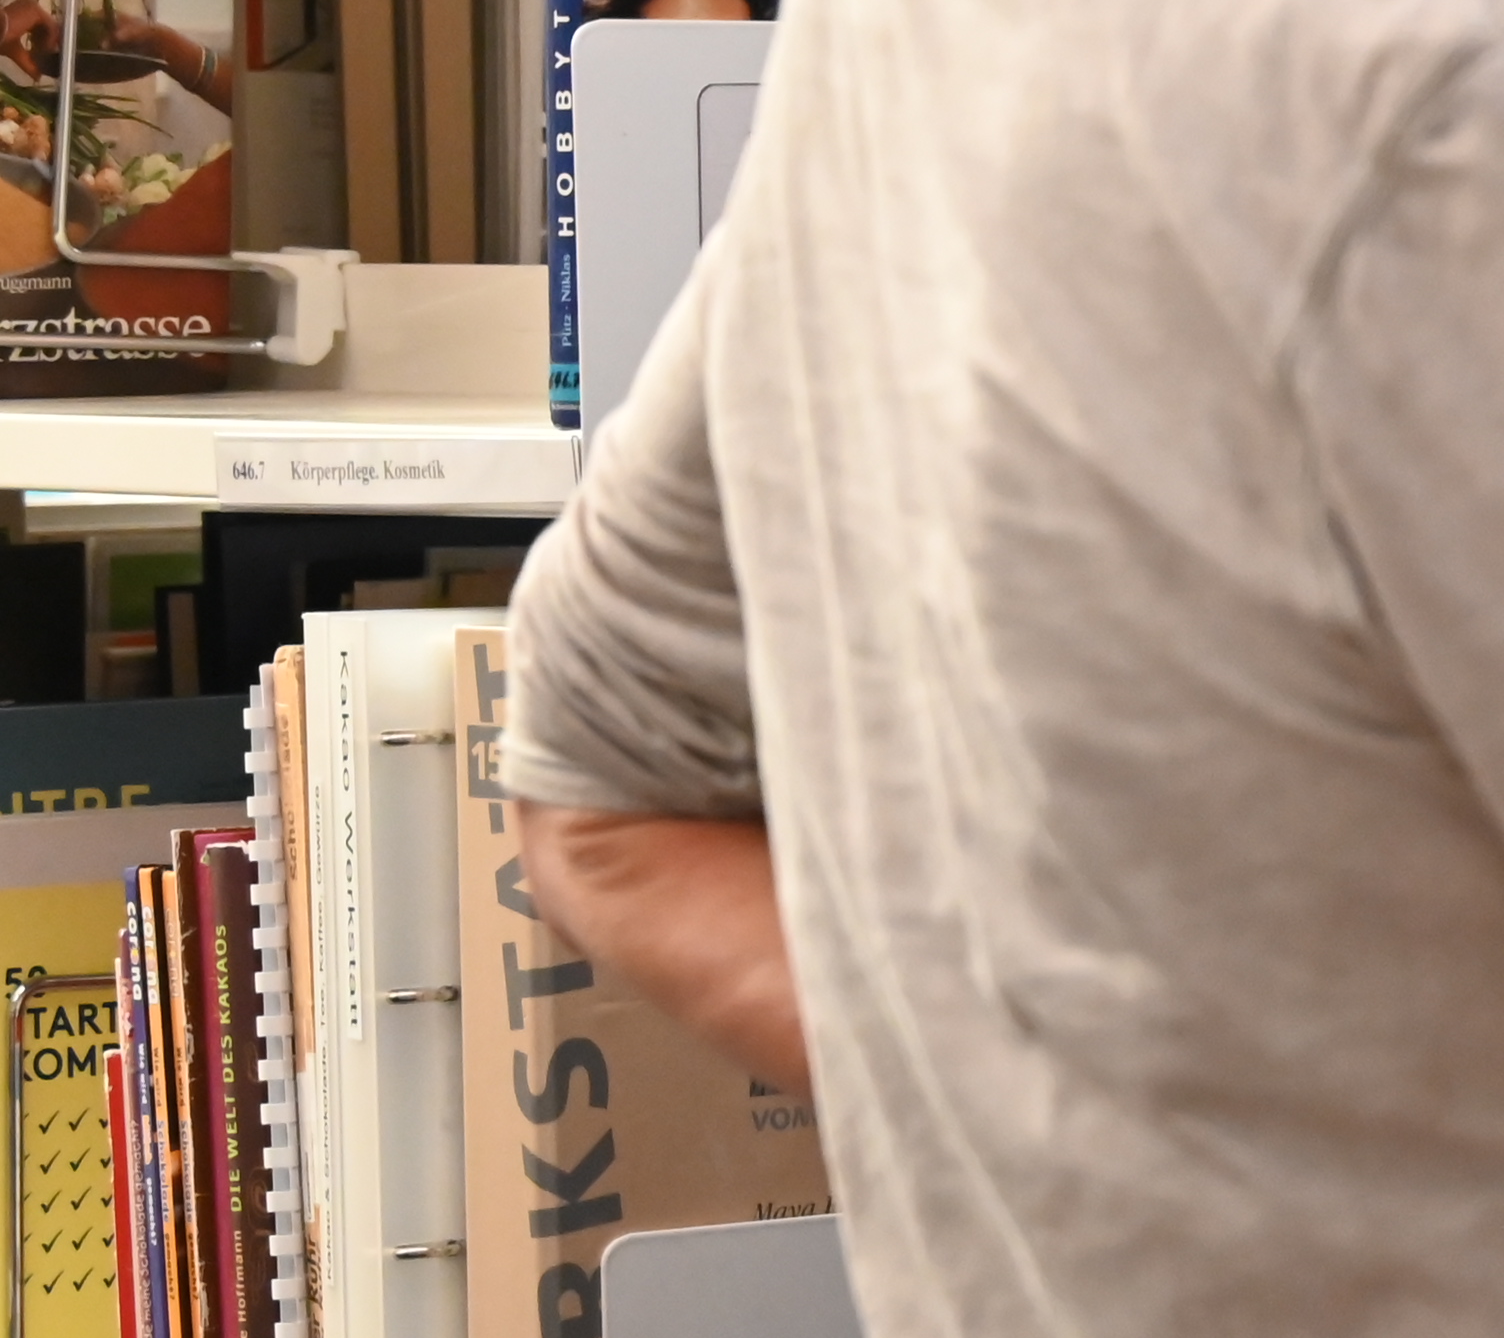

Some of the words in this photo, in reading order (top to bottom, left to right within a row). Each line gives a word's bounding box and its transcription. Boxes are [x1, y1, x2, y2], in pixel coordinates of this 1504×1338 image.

[560, 253, 572, 302] Niklas
[561, 314, 572, 347] Pütz
[232, 460, 265, 480] 646.7
[290, 460, 379, 486] Körperpflege.
[383, 459, 446, 480] Kosmetik
[339, 650, 351, 792] Kakao
[344, 810, 360, 1027] Werkstatt
[214, 924, 231, 1025] KAKAOS
[26, 1002, 119, 1040] TART
[138, 1042, 146, 1069] Wie
[220, 1035, 235, 1084] DES
[138, 1074, 148, 1104] wird
[130, 1119, 145, 1191] gemacht?
[224, 1095, 239, 1159] WELT
[156, 1120, 170, 1223] Schokolade
[180, 1120, 194, 1223] Schokolade
[229, 1169, 243, 1212] DIE
[136, 1194, 150, 1276] Schokolade
[146, 1176, 158, 1247] gemacht?
[140, 1278, 152, 1322] meine
[233, 1229, 248, 1323] Hoffmann
